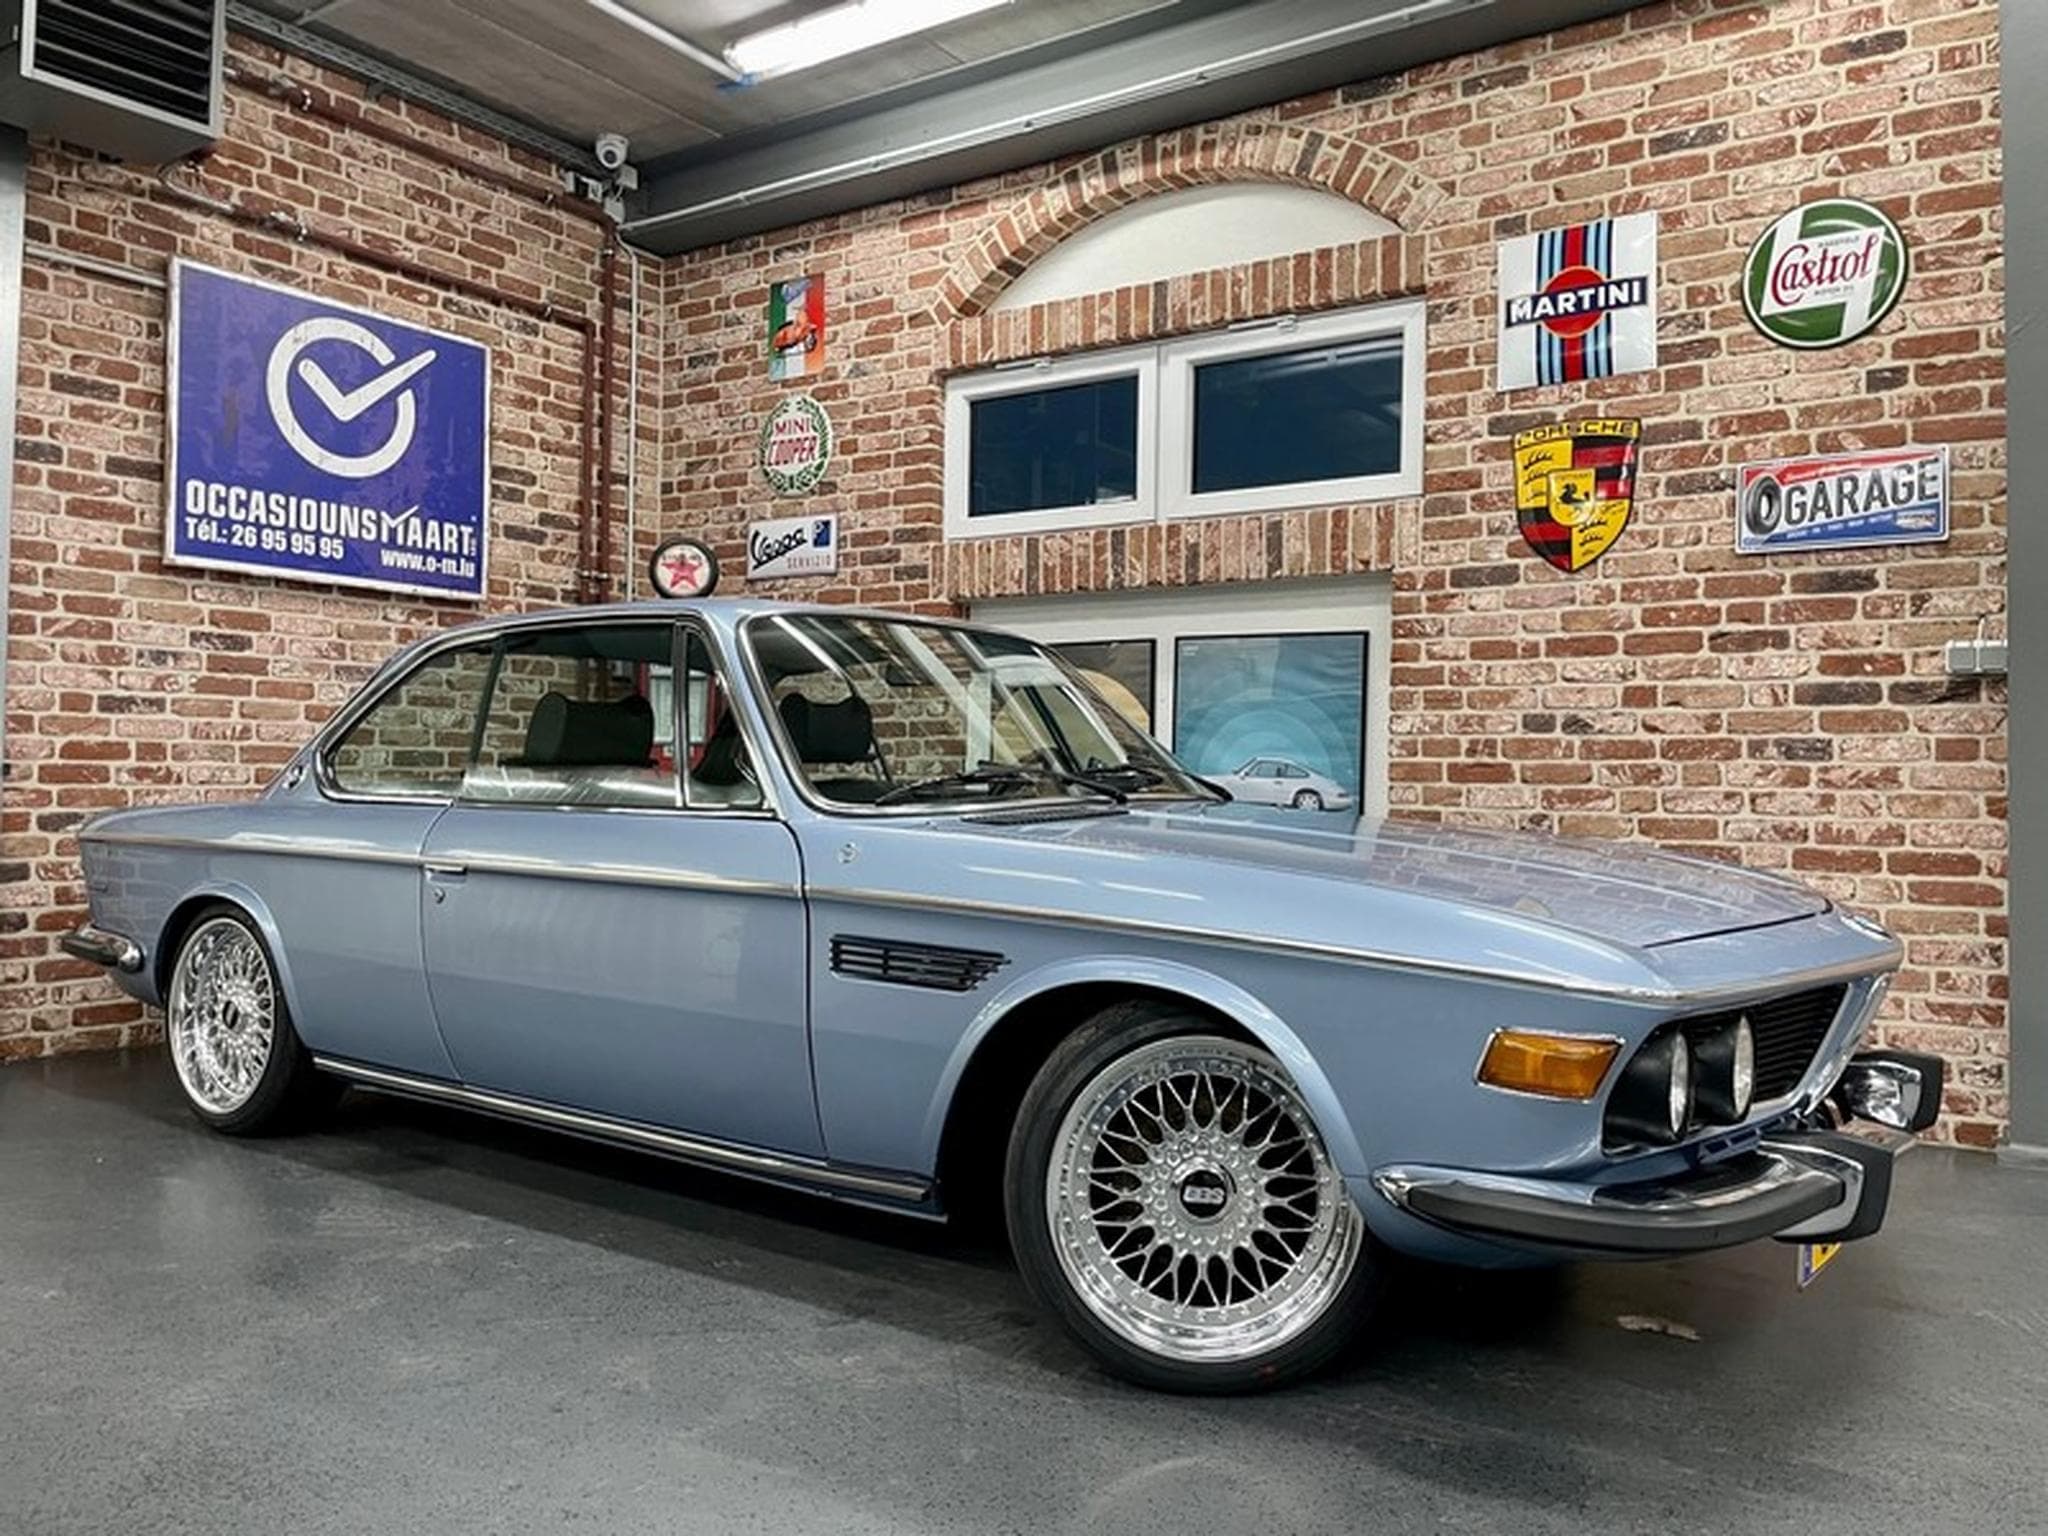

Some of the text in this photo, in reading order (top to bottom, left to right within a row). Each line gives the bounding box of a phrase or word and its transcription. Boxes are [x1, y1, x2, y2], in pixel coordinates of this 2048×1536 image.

[1771, 234, 1879, 307] Castrol
[1510, 280, 1641, 324] MARTINI
[775, 418, 810, 435] MINI
[768, 436, 817, 466] COOPER
[1784, 457, 1939, 525] GARAGE
[186, 518, 344, 560] Tél.: 26 95 95 95
[381, 549, 475, 578] www.o-m.lu
